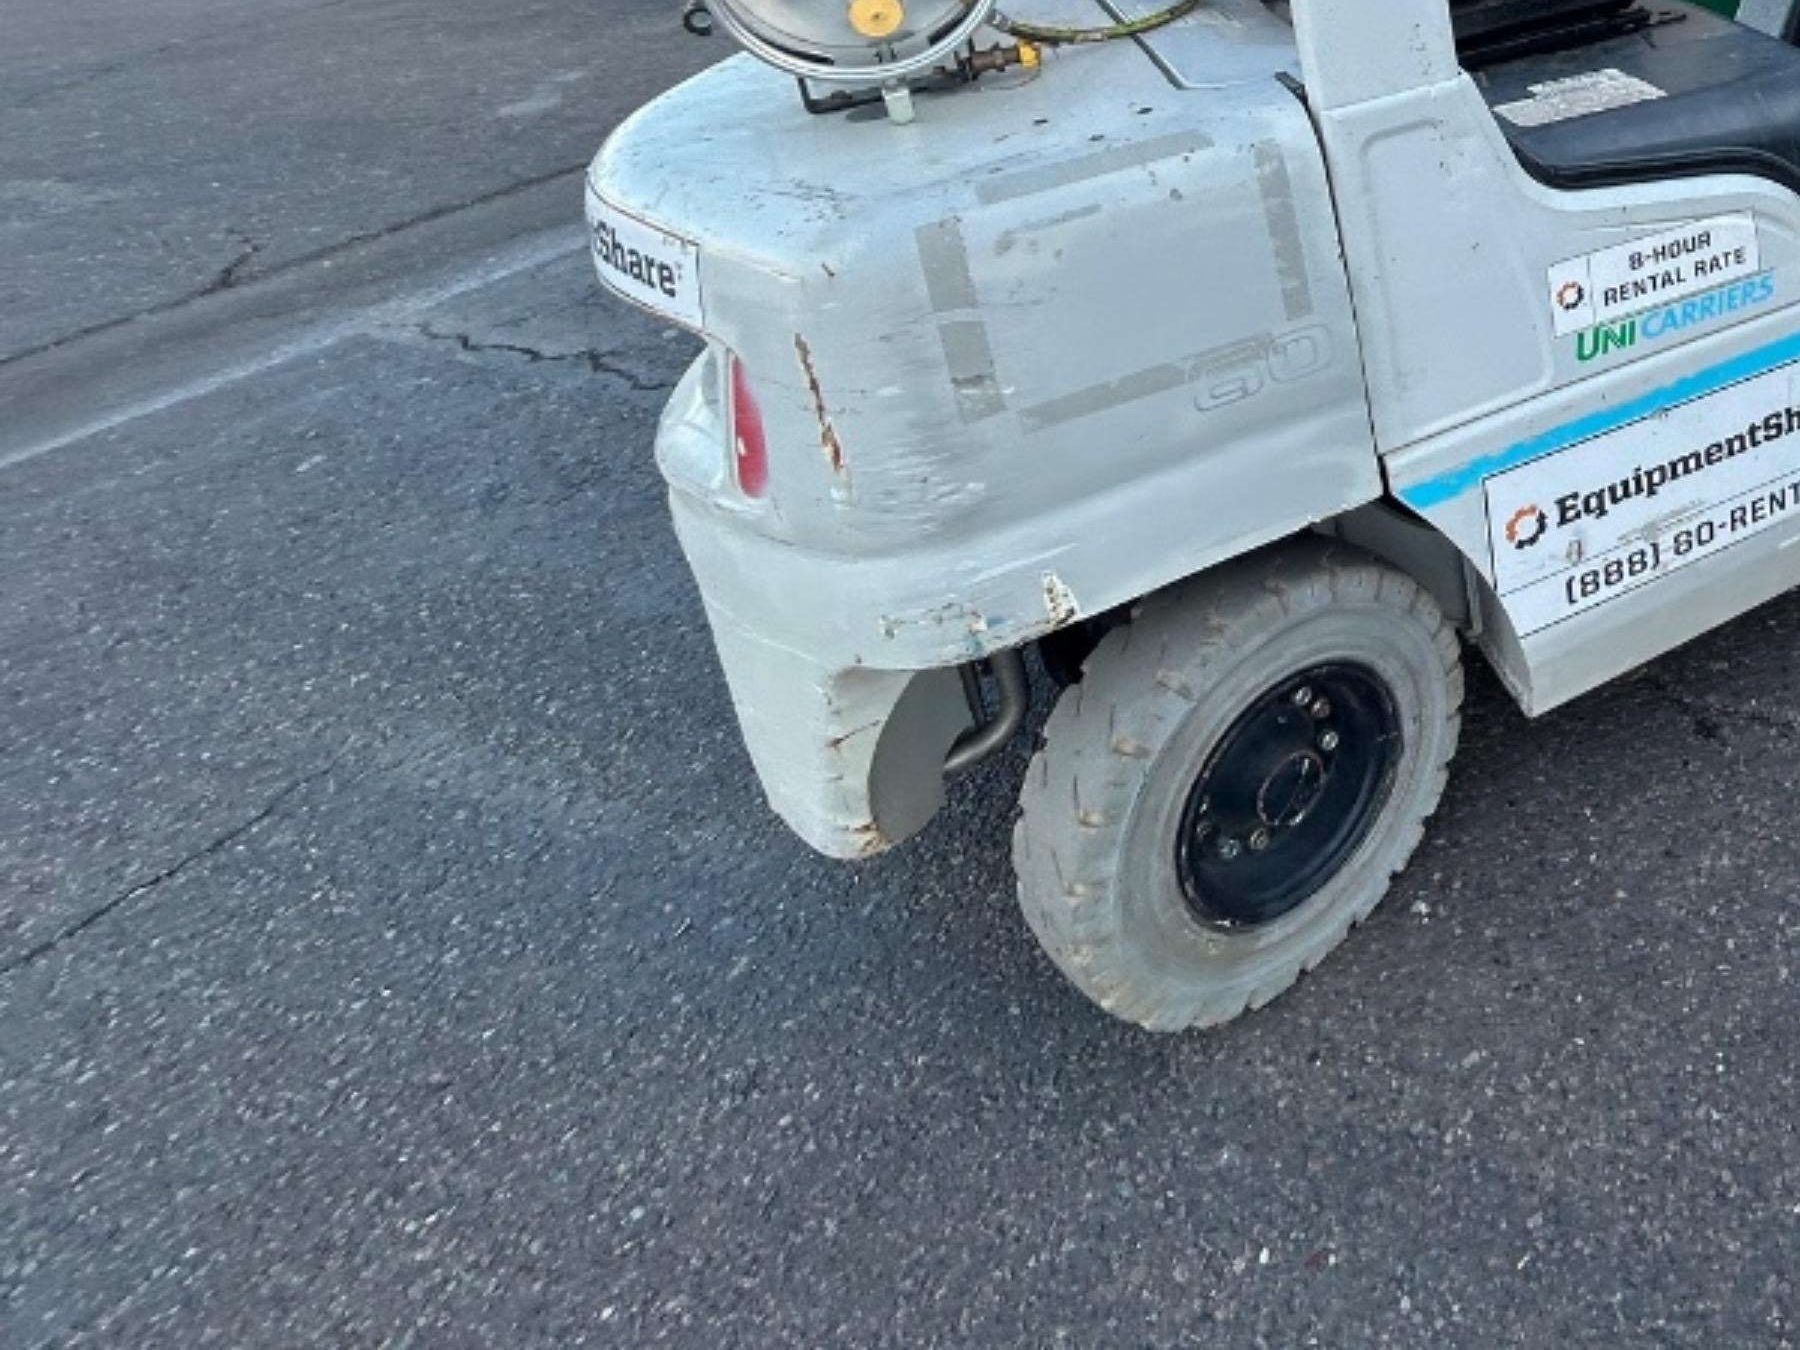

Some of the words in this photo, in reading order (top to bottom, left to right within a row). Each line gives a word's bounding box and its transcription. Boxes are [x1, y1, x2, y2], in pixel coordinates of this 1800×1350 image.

[1604, 266, 1686, 306] RENTAL
[1695, 247, 1746, 277] RATE
[1629, 231, 1711, 271] 8-HOUR
[1576, 275, 1774, 361] UNICARRIERS
[1565, 543, 1661, 605] (888)
